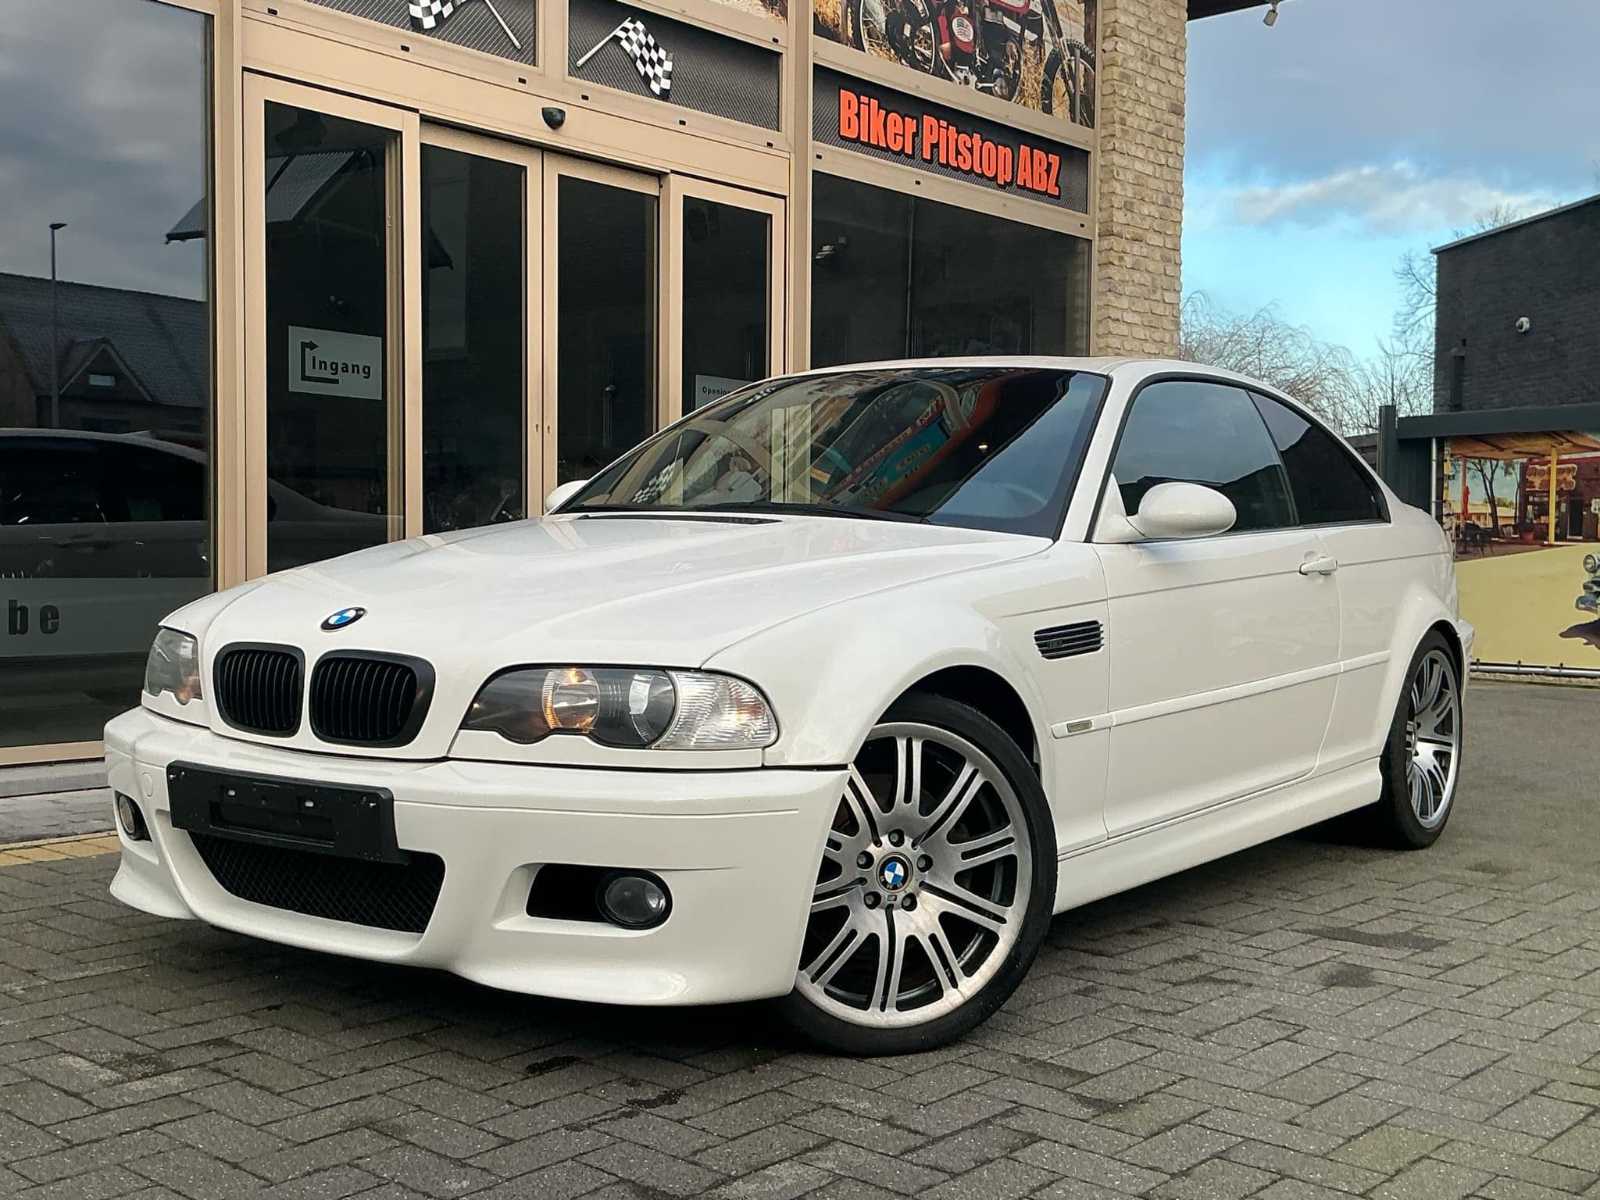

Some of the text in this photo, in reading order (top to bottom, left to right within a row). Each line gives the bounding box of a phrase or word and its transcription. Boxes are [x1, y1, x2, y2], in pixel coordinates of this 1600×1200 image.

[838, 88, 1062, 198] Biker Pitstop ABZ
